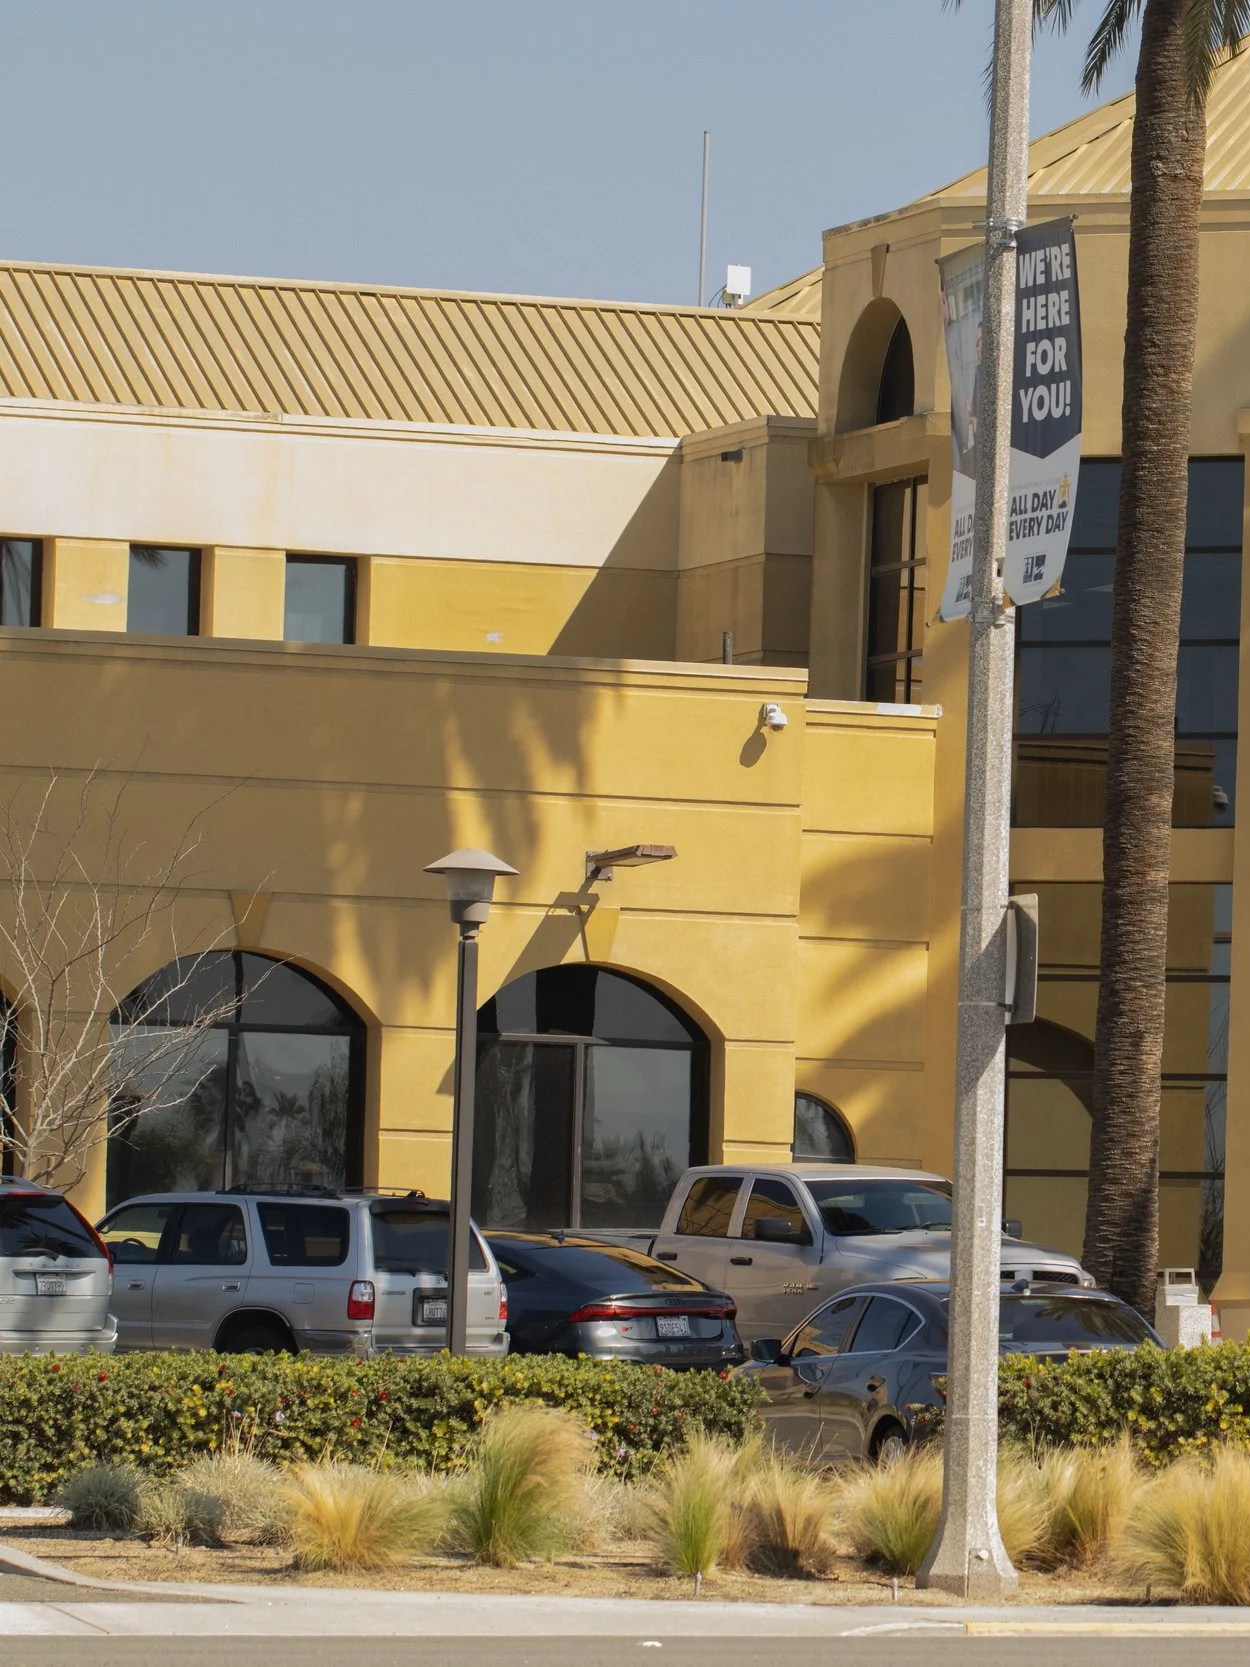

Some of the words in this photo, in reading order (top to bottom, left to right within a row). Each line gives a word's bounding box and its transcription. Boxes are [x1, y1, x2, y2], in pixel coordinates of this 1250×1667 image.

[1019, 243, 1071, 289] WE'RE
[1021, 290, 1070, 333] HERE
[1025, 337, 1067, 377] FOR
[1019, 380, 1071, 423] YOU!
[1010, 494, 1028, 517] ALL
[1031, 489, 1057, 513] DAY
[954, 516, 965, 539] ALL
[1009, 516, 1044, 541] EVERY
[1045, 511, 1069, 535] DAY
